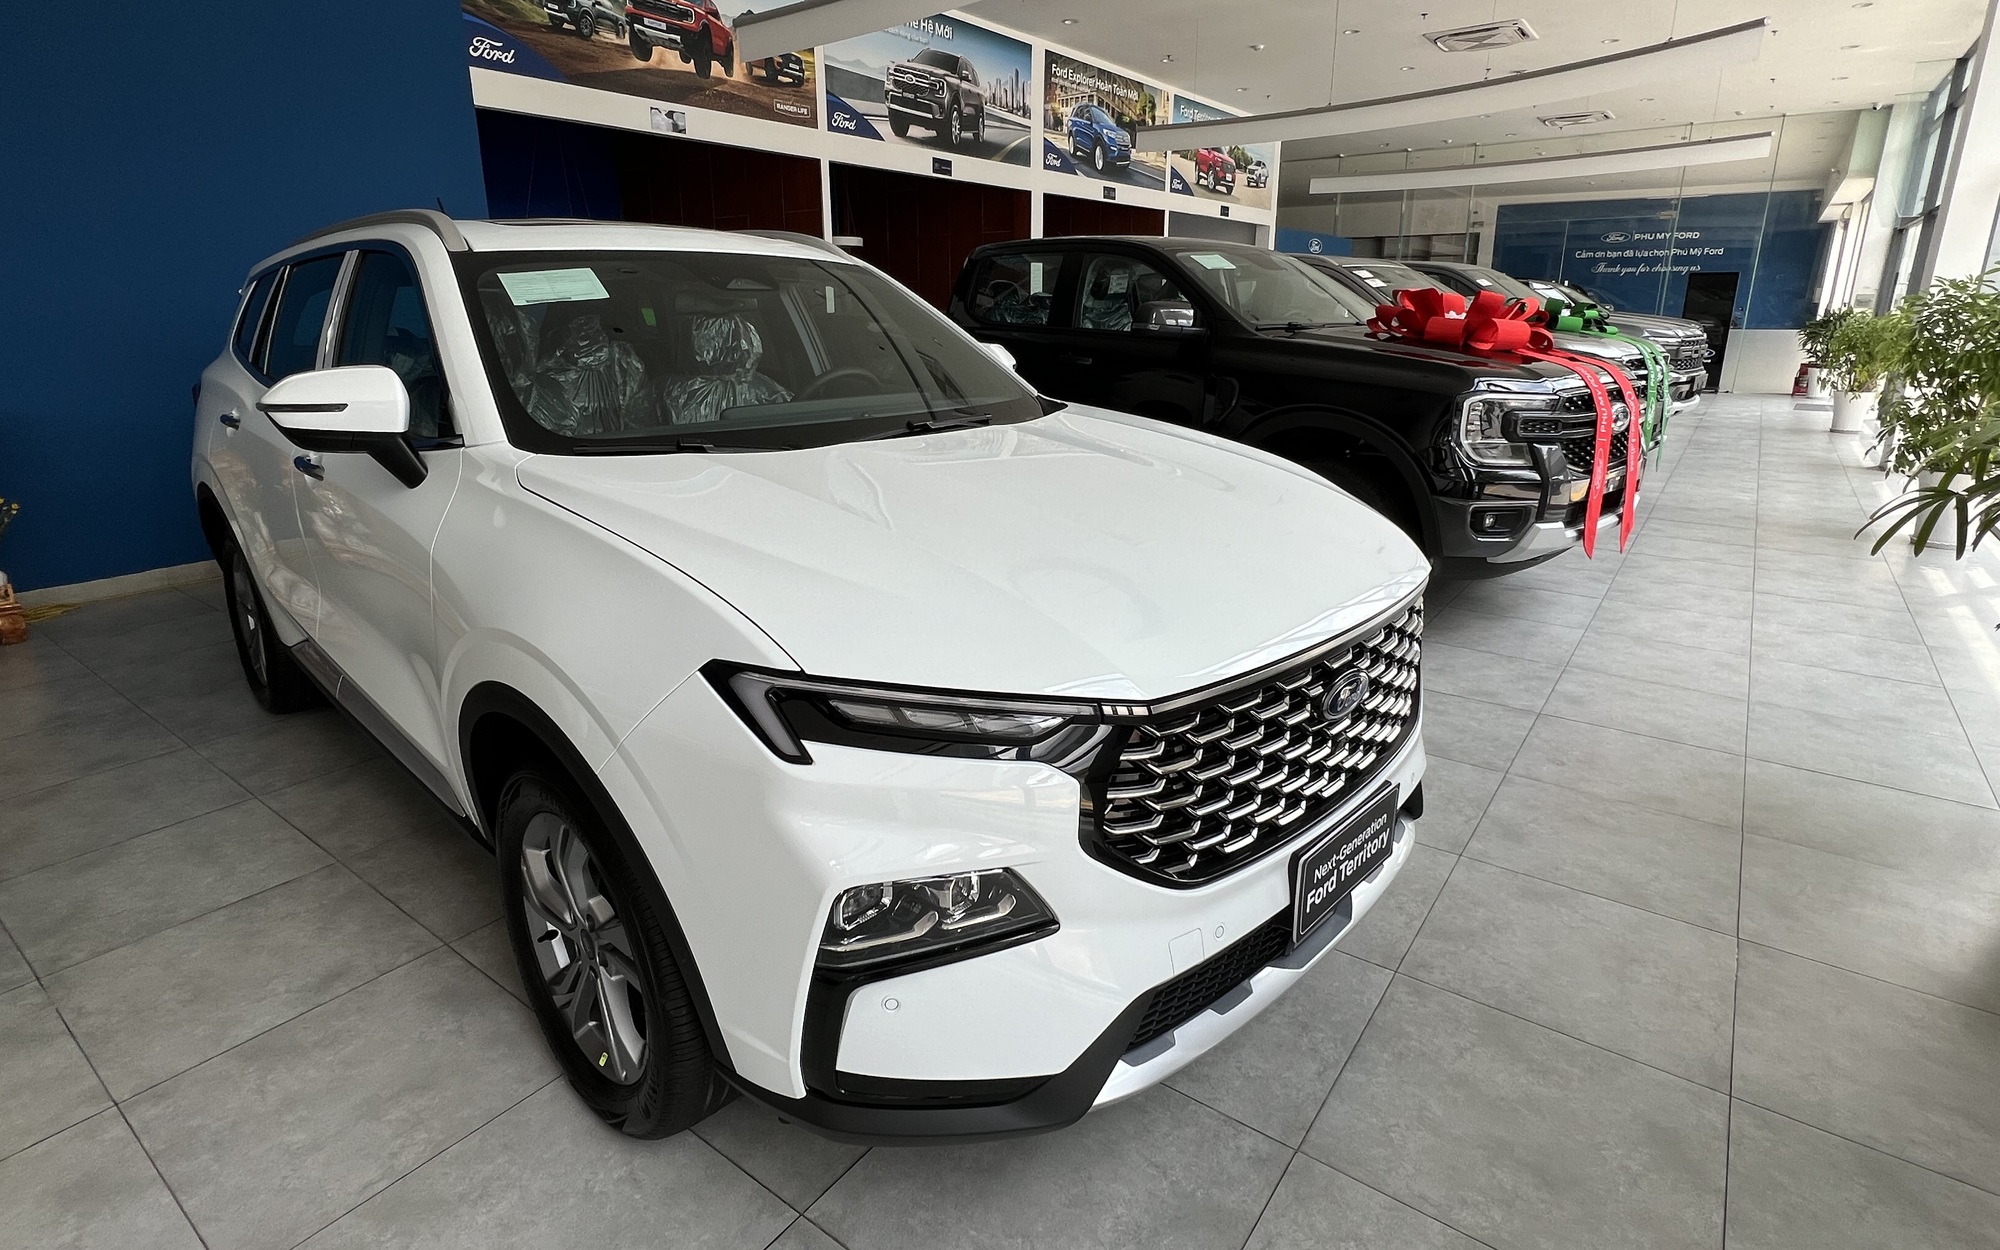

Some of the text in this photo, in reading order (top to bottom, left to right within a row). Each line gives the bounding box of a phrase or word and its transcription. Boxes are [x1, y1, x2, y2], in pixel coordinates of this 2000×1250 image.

[935, 22, 953, 40] Mới
[469, 36, 515, 64] Ford
[1051, 63, 1068, 79] Ford
[1068, 69, 1095, 87] Explorer
[776, 103, 808, 115] RANGER LIFE
[1180, 104, 1194, 119] Ford
[831, 111, 857, 130] Ford
[1045, 152, 1062, 168] Ford
[1171, 178, 1184, 191] Ford
[1655, 232, 1671, 240] MY
[1673, 231, 1700, 240] FORD
[1606, 250, 1622, 259] bạn
[1623, 249, 1634, 257] đã
[1649, 249, 1670, 258] chọn
[1689, 247, 1702, 256] Mỹ
[1703, 247, 1724, 255] Ford
[1591, 262, 1621, 273] Thank
[1620, 266, 1637, 276] you
[1635, 262, 1650, 276] for
[1651, 263, 1689, 276] choosing
[1595, 388, 1605, 406] MY
[1600, 408, 1608, 433] PHU
[1313, 813, 1387, 884] Next-Generation
[1306, 827, 1390, 914] Ford Territory
